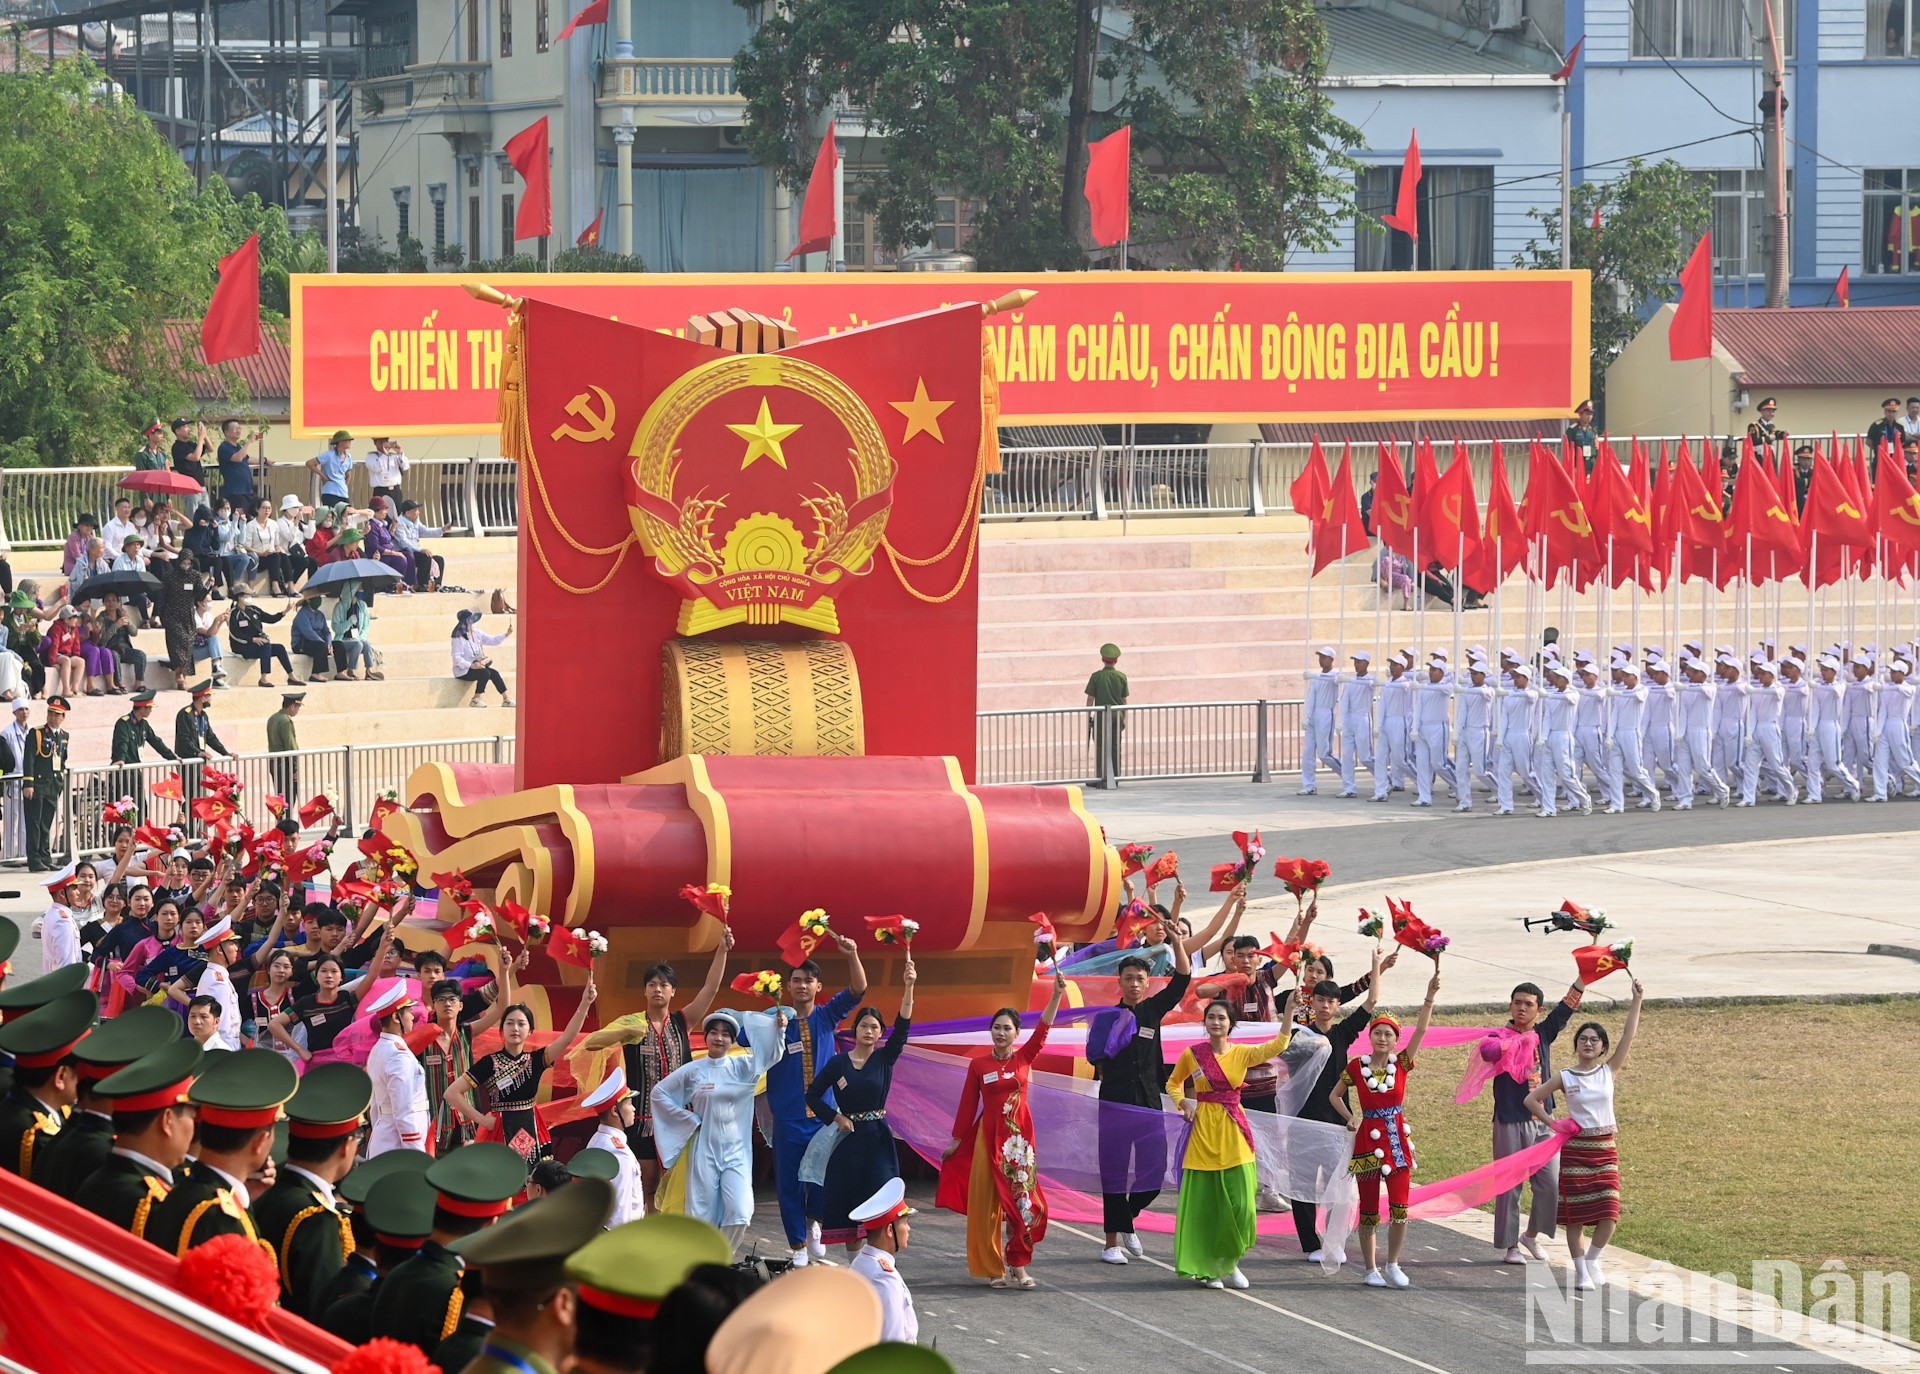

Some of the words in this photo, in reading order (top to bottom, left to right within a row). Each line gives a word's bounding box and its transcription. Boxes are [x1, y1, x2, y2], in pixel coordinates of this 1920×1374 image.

[370, 310, 458, 391] CHIẾN
[984, 312, 1056, 382] NĂM
[1067, 311, 1158, 388] CHÂU,
[1168, 303, 1251, 381] CHẤN
[1260, 311, 1346, 393] ĐỘNG
[1355, 322, 1410, 392] ĐỊA
[1419, 302, 1499, 379] CẦU!
[719, 577, 736, 588] CỘNG
[765, 573, 775, 581] HỘI
[777, 574, 790, 582] CHỦ
[792, 577, 811, 587] NGHĨA
[725, 583, 762, 602] VIỆT
[767, 586, 805, 602] NAM
